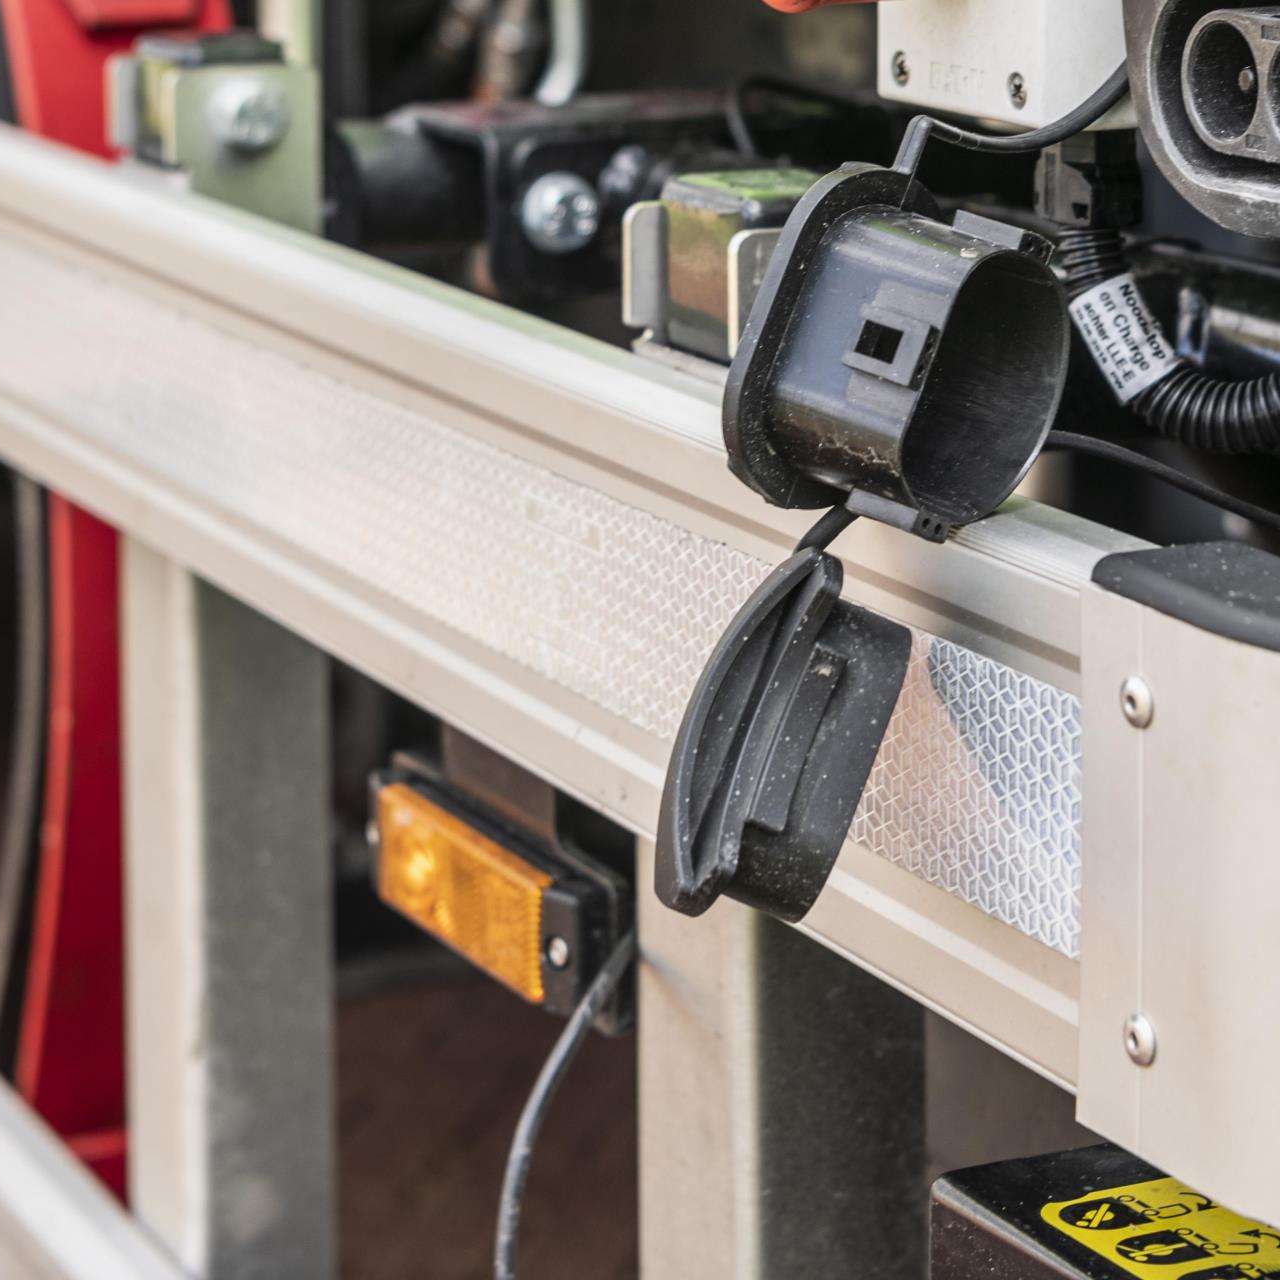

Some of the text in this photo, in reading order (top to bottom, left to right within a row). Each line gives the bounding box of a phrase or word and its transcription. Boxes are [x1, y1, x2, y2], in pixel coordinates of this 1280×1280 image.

[1083, 303, 1135, 382] achter LLE-E
[1099, 292, 1150, 371] en Charge
[1119, 283, 1166, 360] Noodstop
